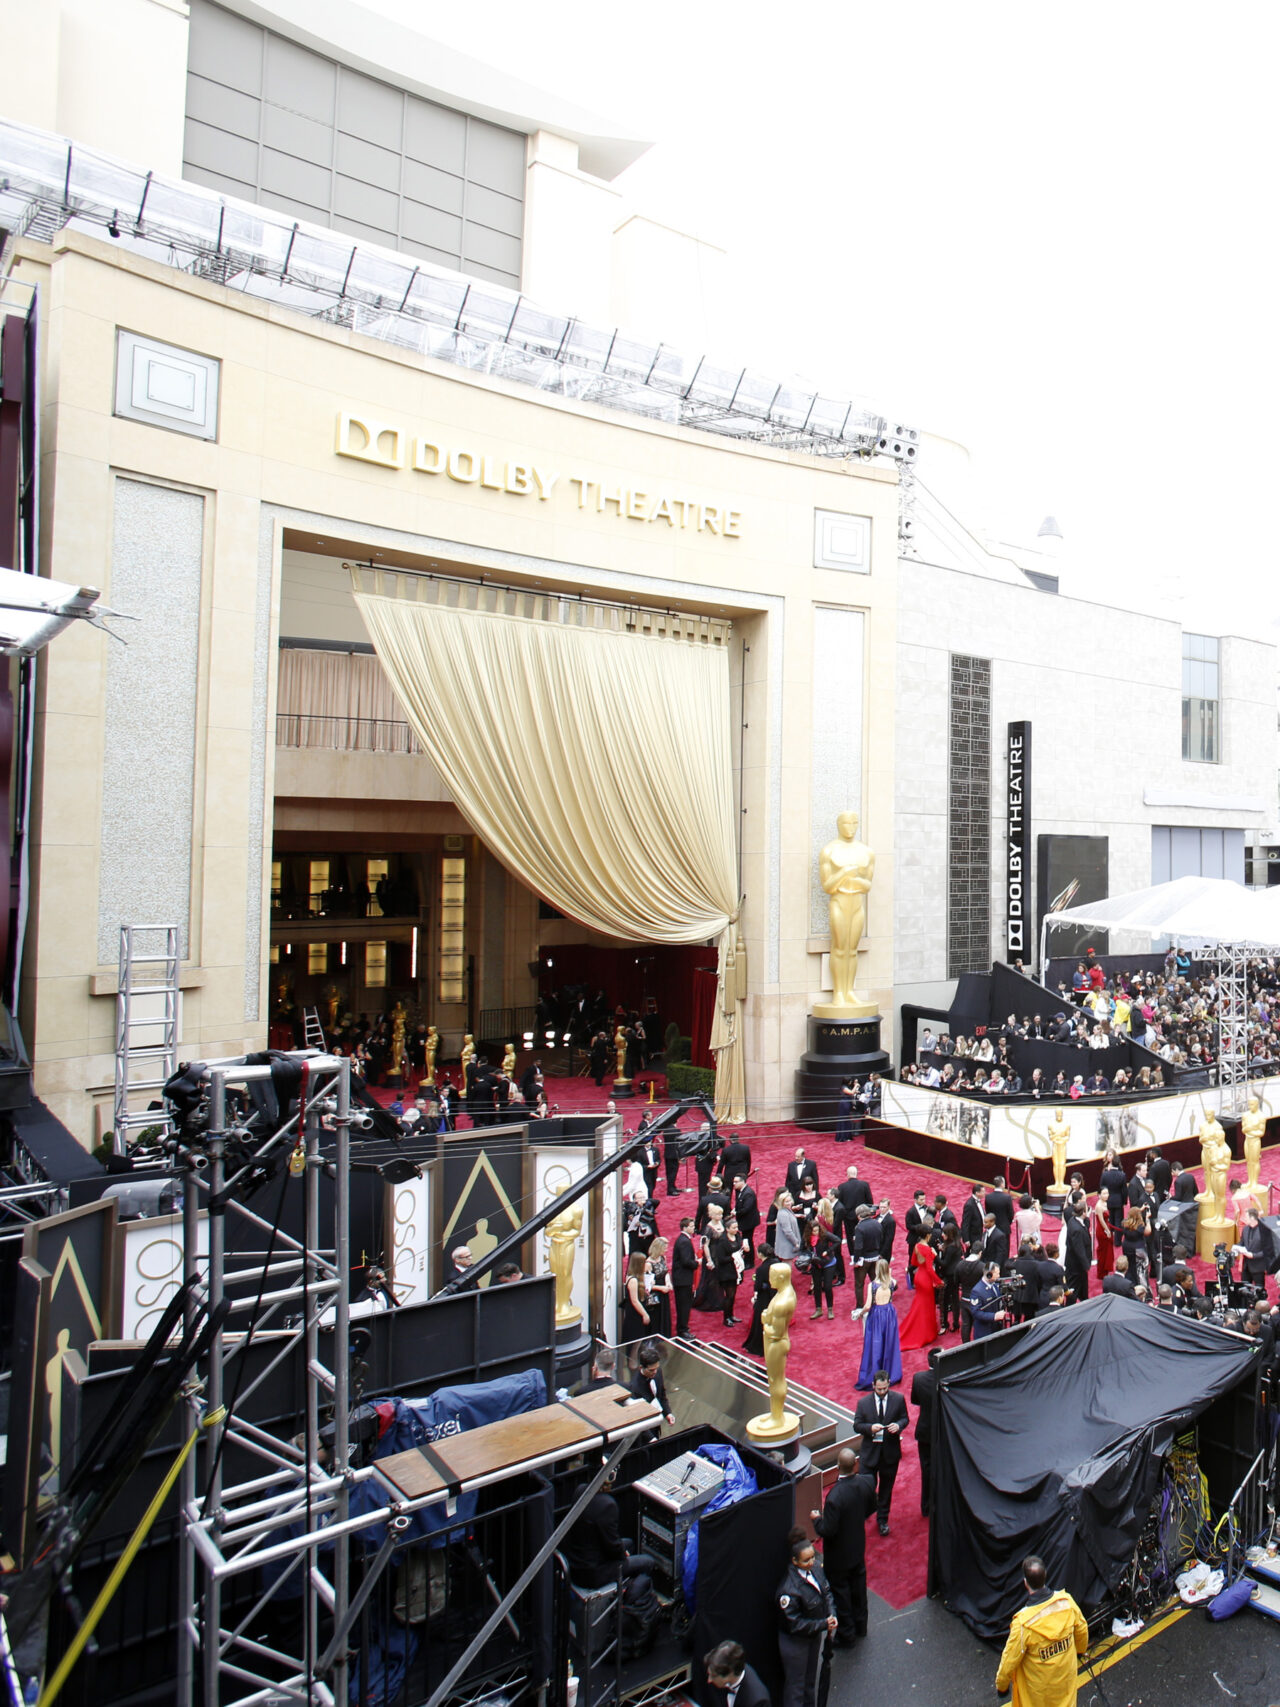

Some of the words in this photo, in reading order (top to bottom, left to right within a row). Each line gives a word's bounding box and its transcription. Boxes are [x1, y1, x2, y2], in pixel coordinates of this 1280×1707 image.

[412, 436, 561, 501] DOLBY
[570, 477, 742, 538] THEATRE
[1009, 735, 1022, 837] THEATRE
[1009, 842, 1022, 916] DOLBY
